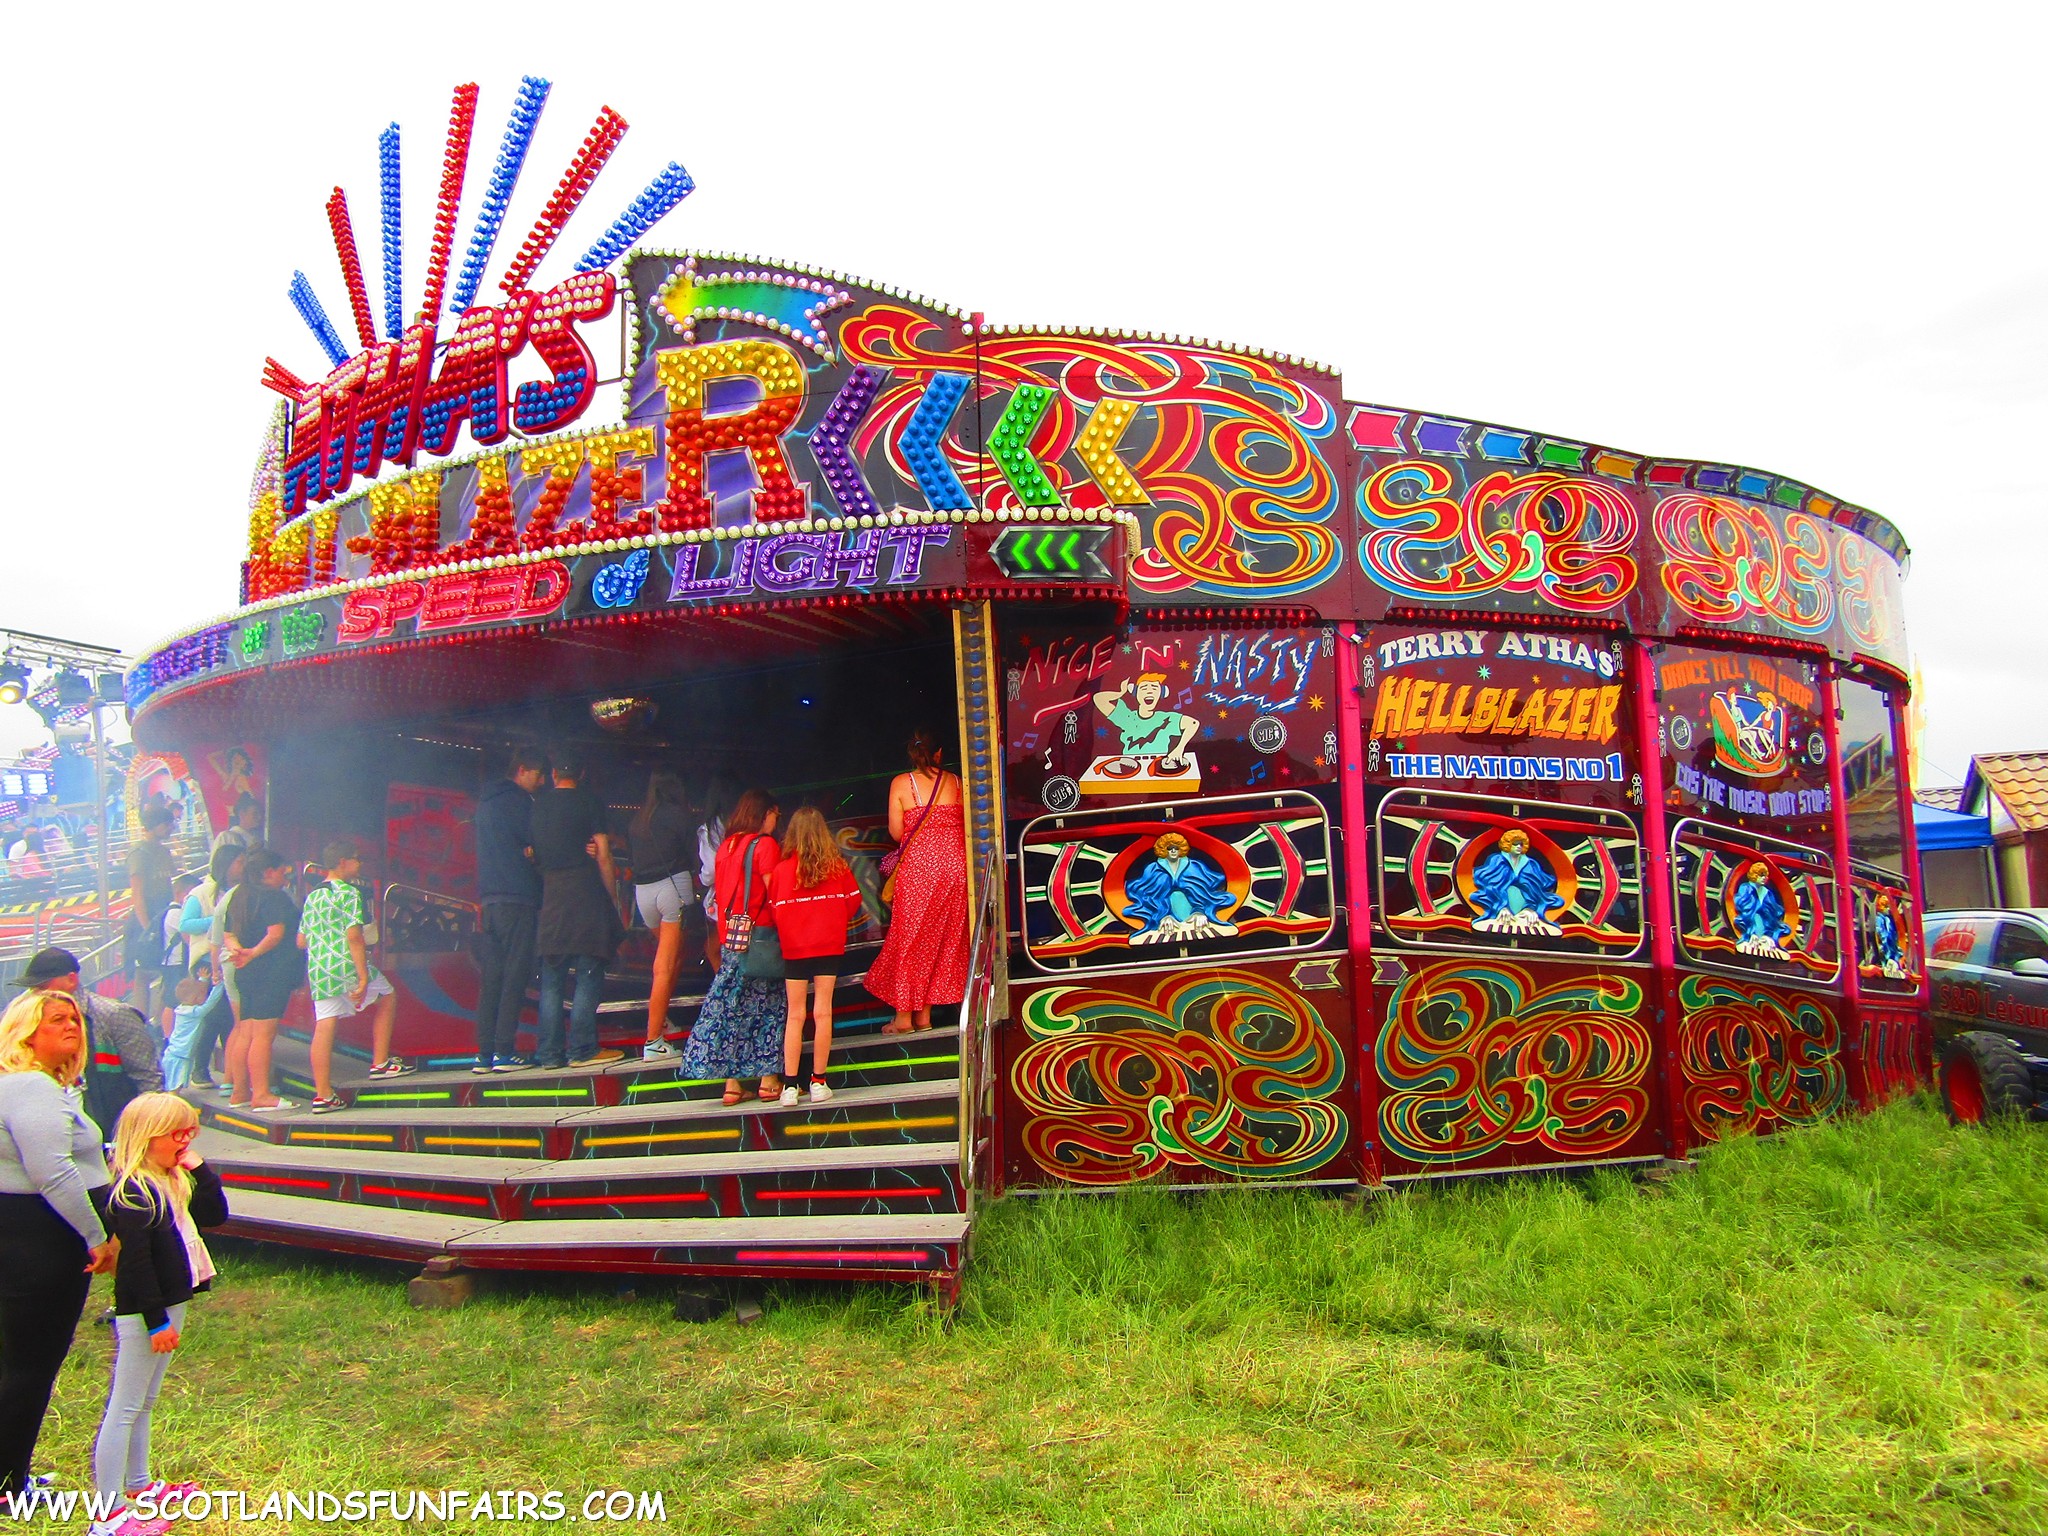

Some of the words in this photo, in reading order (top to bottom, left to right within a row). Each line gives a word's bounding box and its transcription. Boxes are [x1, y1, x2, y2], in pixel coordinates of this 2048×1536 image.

[283, 271, 615, 514] ATHA'S
[336, 560, 571, 645] SPEED
[667, 525, 951, 602] LIGHT
[1193, 630, 1321, 692] NASTY
[1378, 630, 1488, 670] TERRY
[1496, 630, 1614, 680] ATHA'S
[1660, 659, 1711, 691] DANCE
[1710, 654, 1745, 682] TILL
[1748, 656, 1777, 693] YOU
[1778, 673, 1816, 711] DROP
[1369, 674, 1624, 745] HELLBLAZER
[1385, 753, 1443, 778] THE
[1444, 754, 1564, 780] NATIONS
[1675, 761, 1700, 796] COS
[1701, 773, 1726, 807] THE
[1728, 786, 1768, 815] MUSIC
[1798, 788, 1827, 814] STOP
[1939, 984, 1979, 1016] S&D
